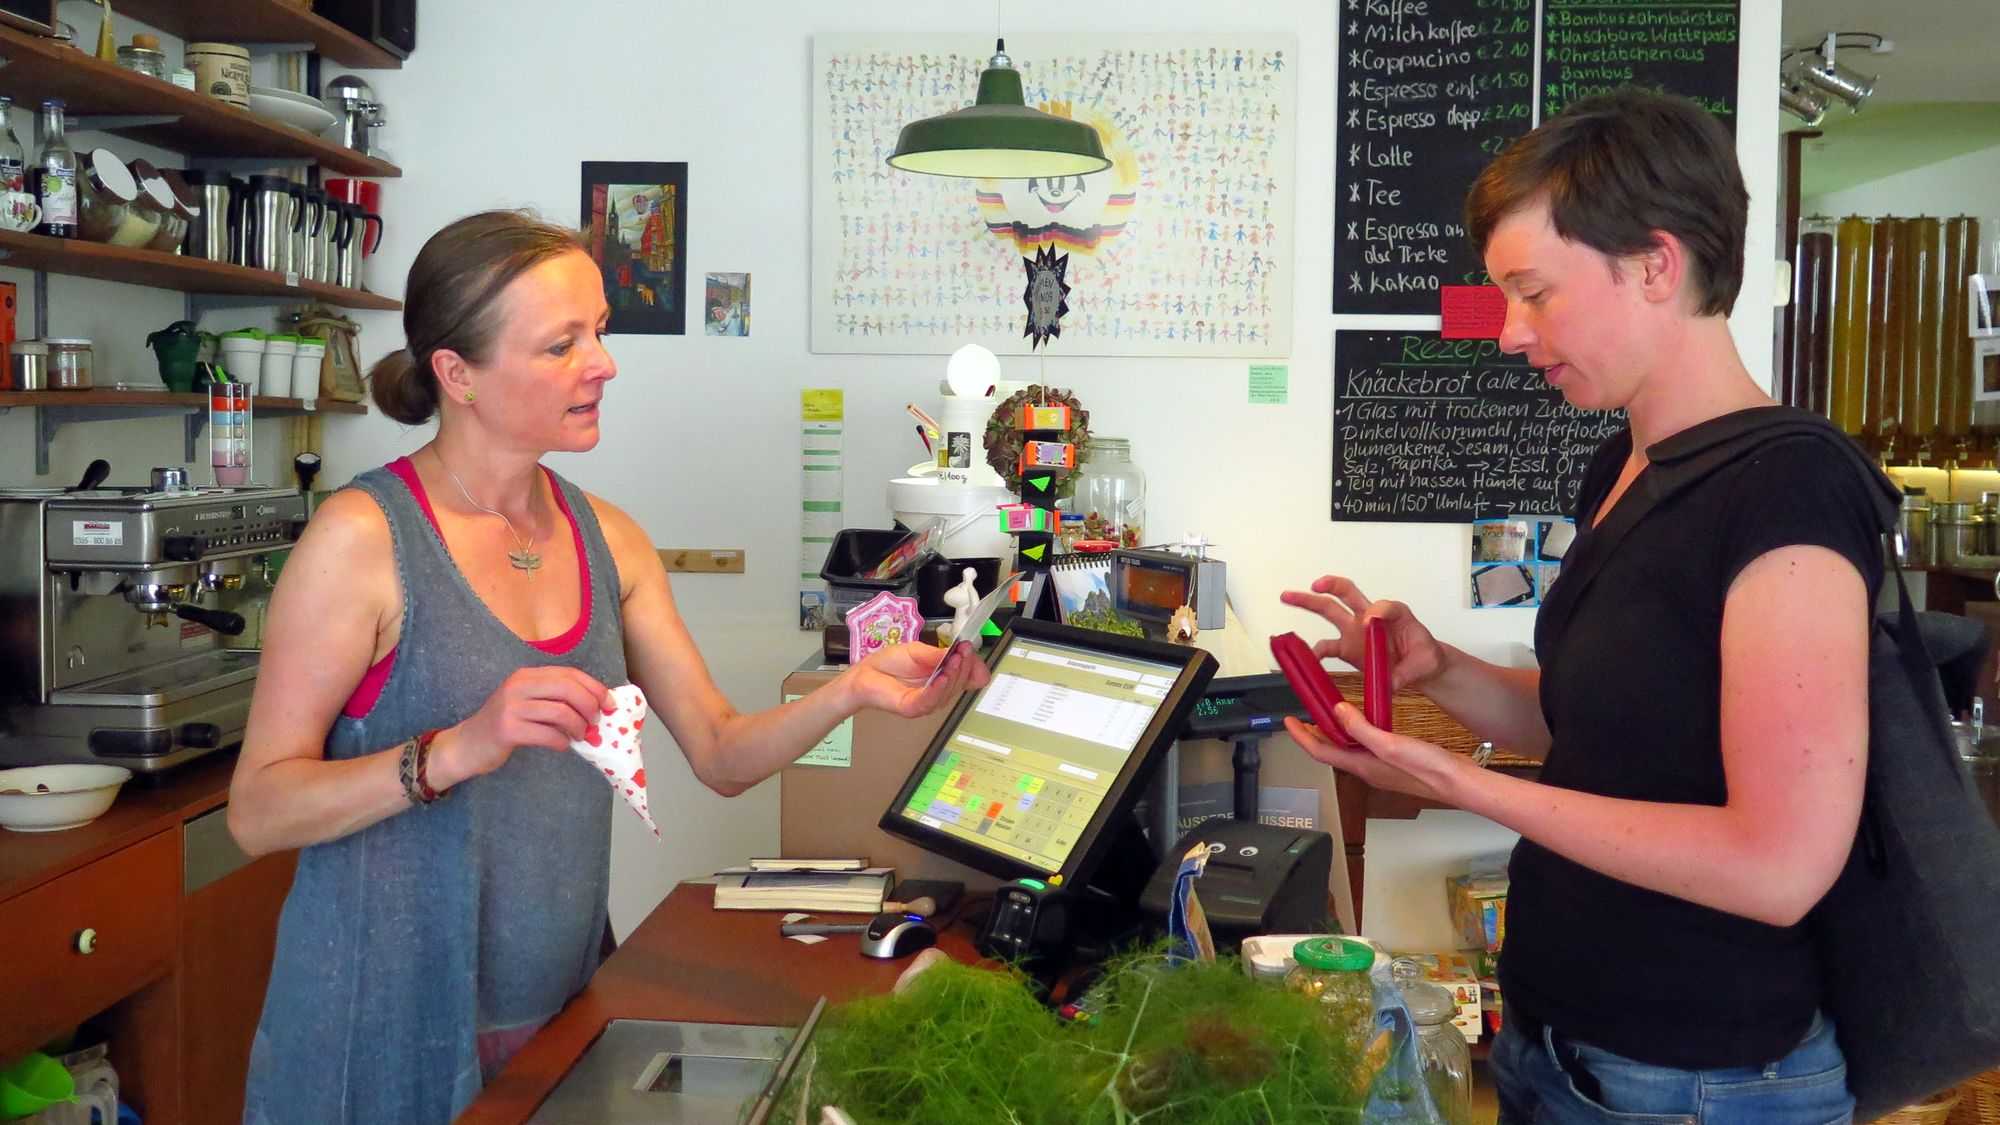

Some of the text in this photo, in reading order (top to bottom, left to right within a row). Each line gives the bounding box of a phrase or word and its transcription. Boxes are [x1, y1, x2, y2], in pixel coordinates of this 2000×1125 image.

[1365, 0, 1429, 24] Kaffee
[1560, 10, 1736, 26] Bambuszahnbürsten
[1561, 27, 1736, 46] Waschbare Wattepads
[1362, 48, 1471, 75] Cappucino
[1559, 43, 1705, 64] Ohrstäbchen aus
[1561, 66, 1634, 80] Bambus
[1364, 78, 1438, 108] Espresso
[1366, 109, 1435, 137] Espresso
[1448, 104, 1485, 131] dopp.
[1368, 142, 1413, 166] Latte
[1366, 178, 1402, 205] Tee
[1366, 218, 1438, 249] Espresso
[1365, 245, 1390, 264] der
[1401, 336, 1502, 366] Rezep
[1346, 368, 1472, 398] Knäckebrot
[1477, 371, 1521, 391] (alle
[1342, 403, 1354, 420] 1
[1357, 402, 1398, 420] Glas
[1405, 401, 1437, 418] mit
[1446, 399, 1529, 420] trockenen
[1452, 437, 1514, 458] Sesam,
[1343, 459, 1385, 476] Salz,
[1387, 454, 1457, 476] Paprika
[1494, 457, 1505, 473] 2
[1510, 457, 1549, 474] Essl.
[1556, 452, 1574, 475] Öl
[1346, 475, 1374, 494] Teig
[1380, 472, 1405, 489] mit
[1409, 475, 1467, 489] nassen
[1473, 471, 1526, 491] Hände
[1532, 473, 1561, 497] auf
[1436, 492, 1491, 519] Umluft
[1519, 496, 1562, 514] nach
[1257, 815, 1313, 829] USSERE
